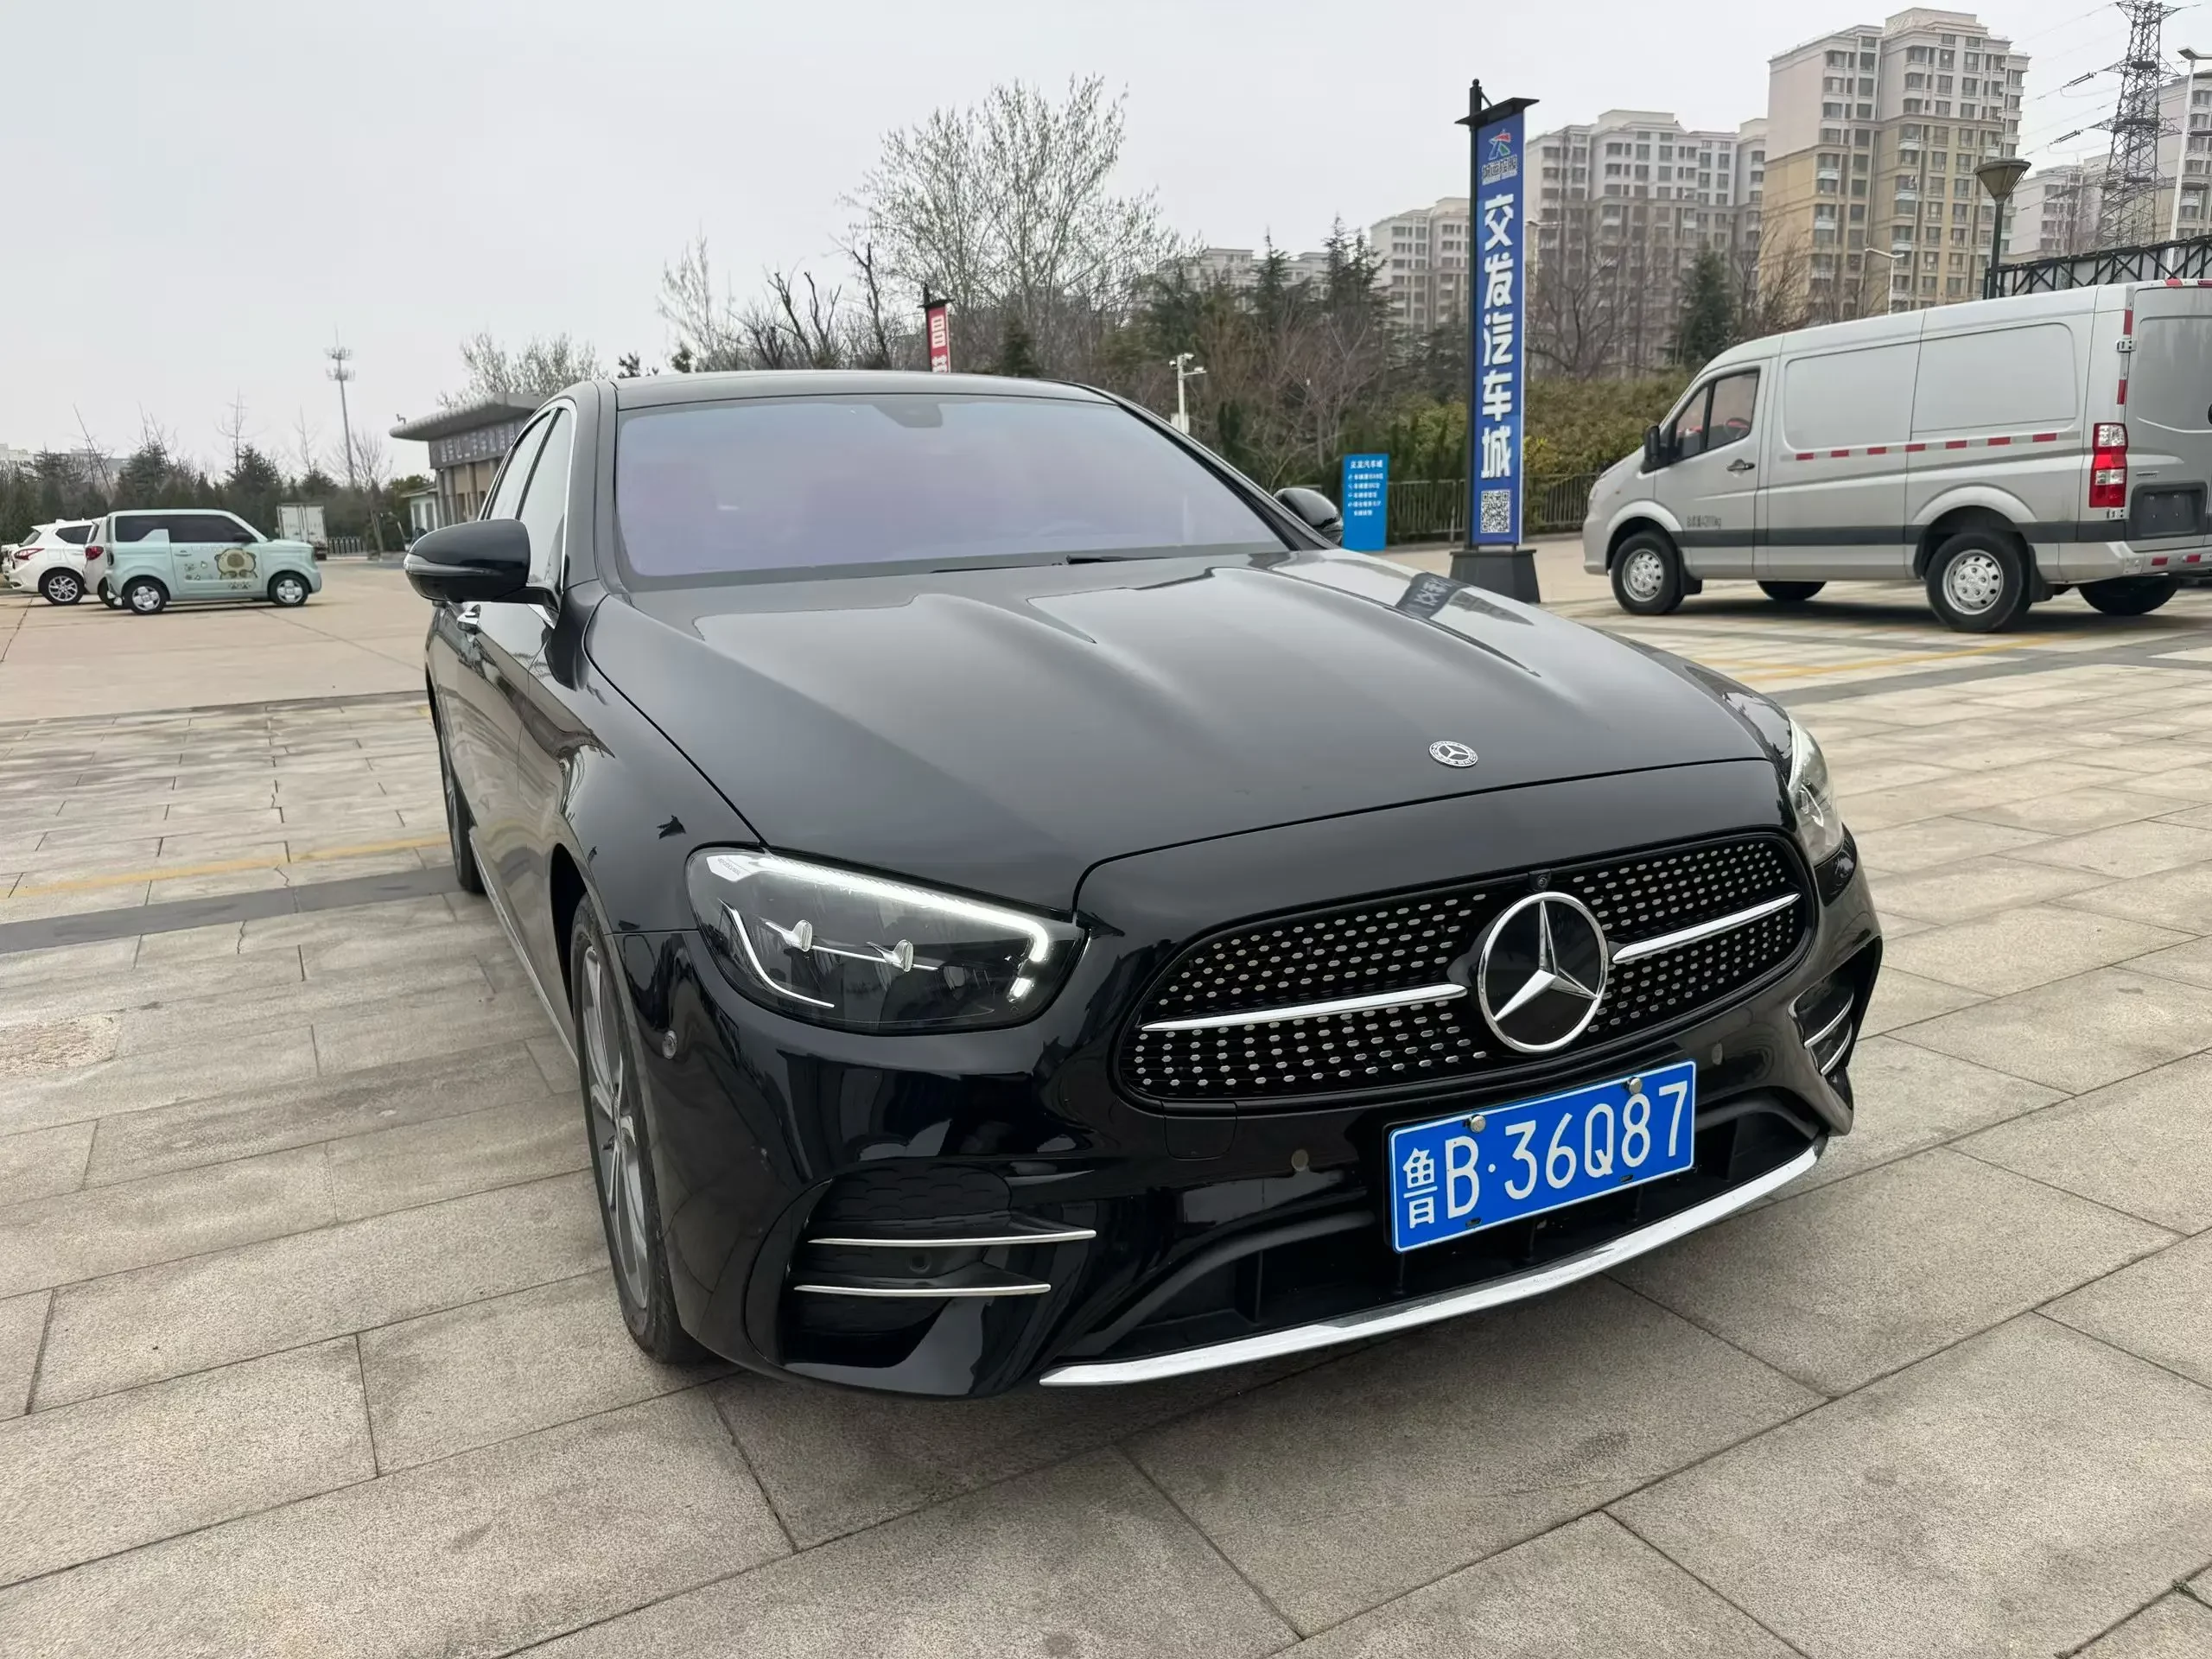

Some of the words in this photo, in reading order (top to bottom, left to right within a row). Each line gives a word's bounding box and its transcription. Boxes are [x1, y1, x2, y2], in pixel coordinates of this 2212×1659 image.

[1481, 194, 1514, 479] 交发汽车城
[1402, 1080, 1688, 1229] 鲁B·36Q87
